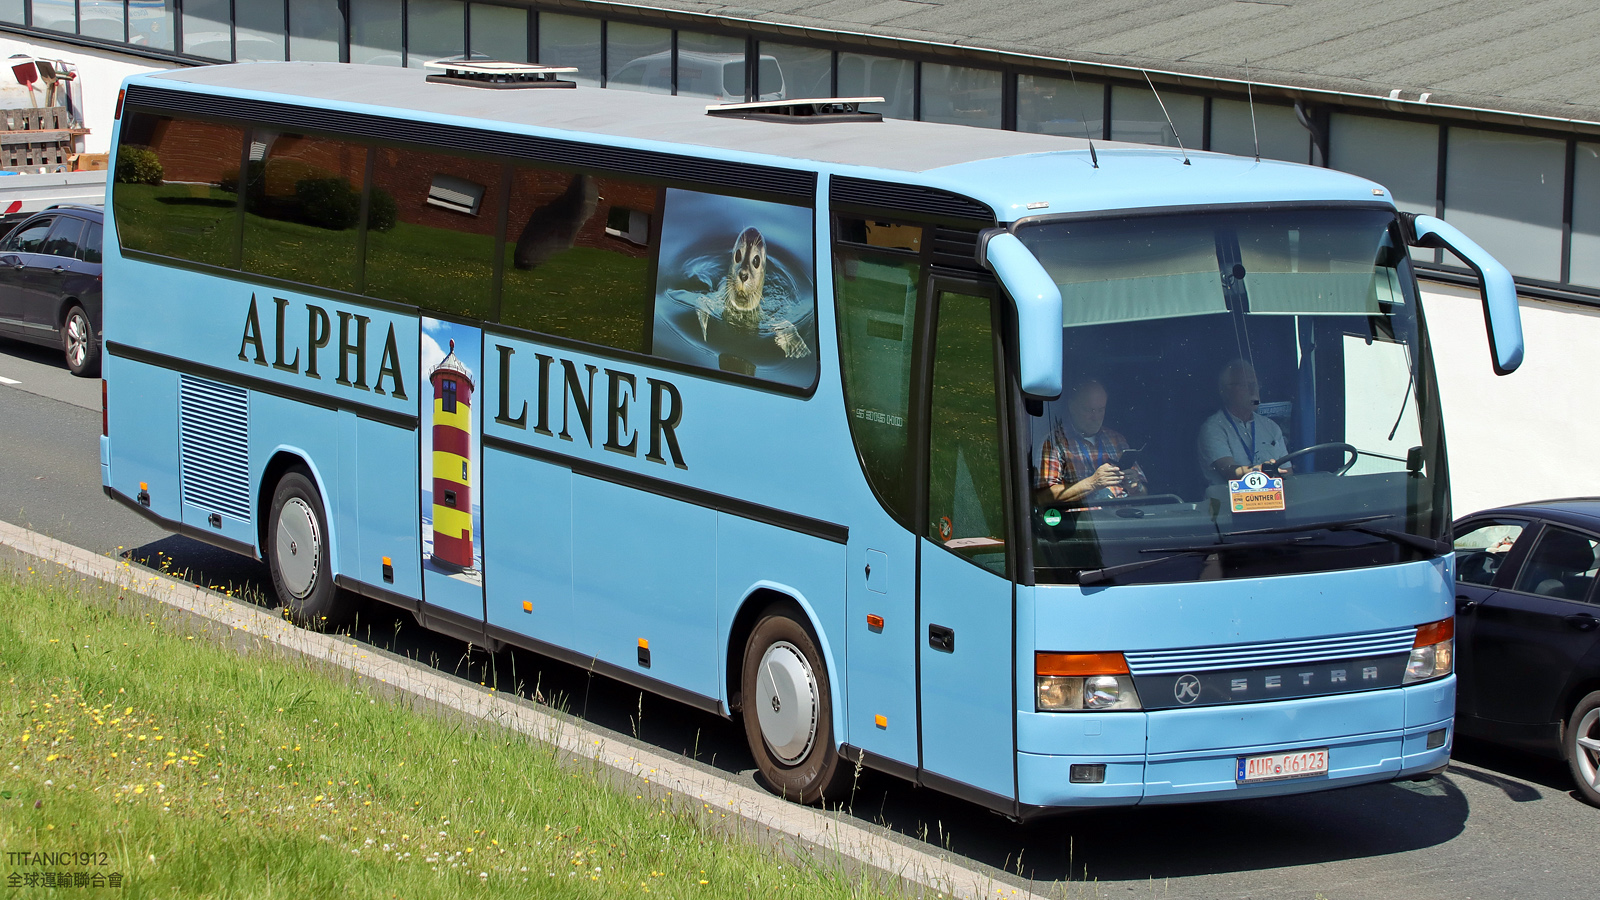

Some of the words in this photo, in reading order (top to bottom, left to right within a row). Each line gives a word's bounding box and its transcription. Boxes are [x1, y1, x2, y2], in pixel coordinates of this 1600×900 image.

[238, 292, 408, 400] ALPHA
[495, 343, 688, 471] LINER
[1250, 477, 1261, 485] 61
[1245, 494, 1274, 502] GÜNTHER
[1050, 509, 1055, 517] 4
[1231, 666, 1378, 691] SETRA
[1248, 757, 1273, 775] AUR
[1283, 752, 1325, 773] 06123
